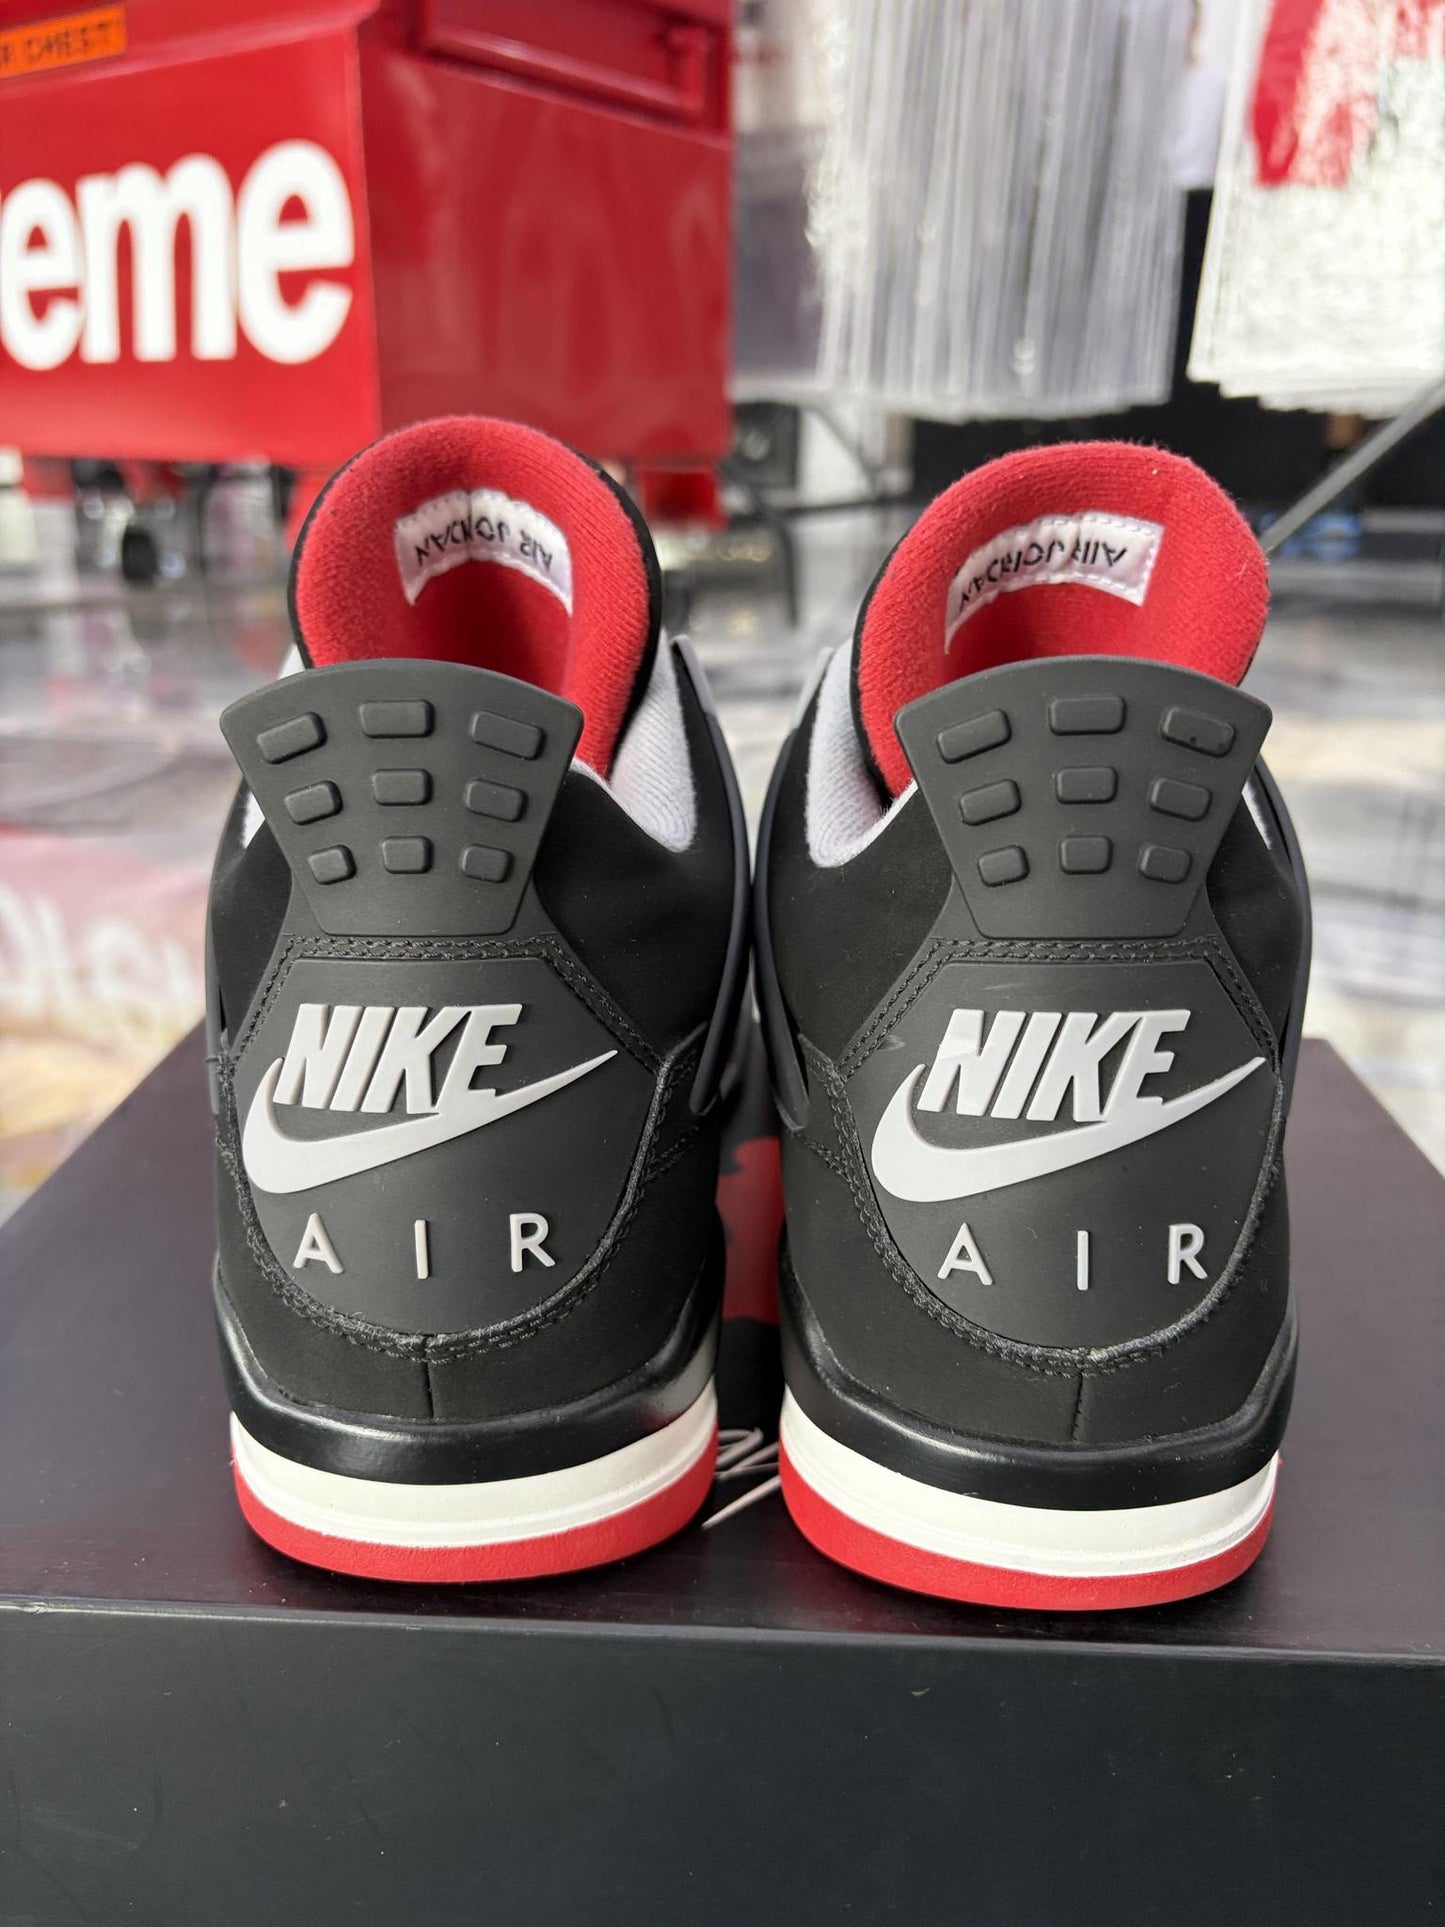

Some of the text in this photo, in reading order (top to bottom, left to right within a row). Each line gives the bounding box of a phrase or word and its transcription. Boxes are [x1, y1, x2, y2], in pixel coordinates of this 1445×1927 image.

[414, 515, 553, 570] AIR JORDAN
[1070, 537, 1127, 567] AIR
[273, 1002, 523, 1115] NIKE
[916, 1008, 1192, 1122] NIKE
[293, 1212, 556, 1280] AIR
[937, 1222, 1209, 1291] AIR
